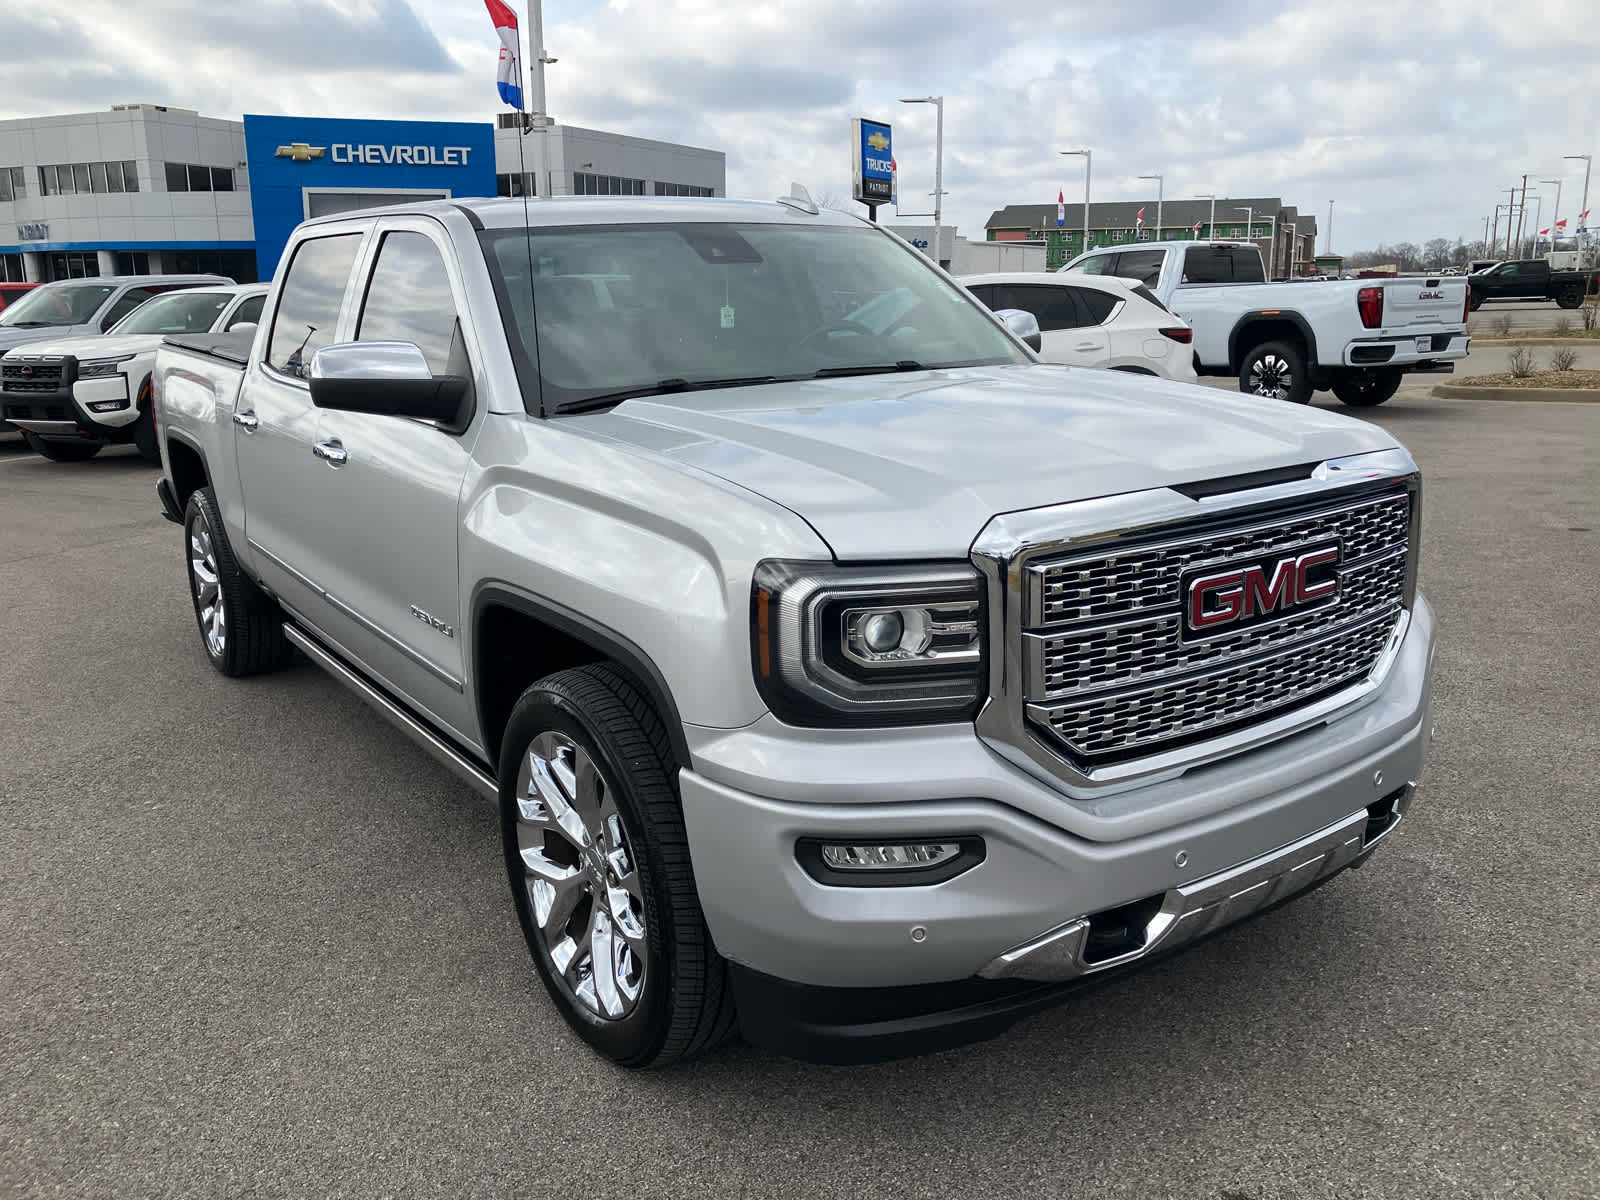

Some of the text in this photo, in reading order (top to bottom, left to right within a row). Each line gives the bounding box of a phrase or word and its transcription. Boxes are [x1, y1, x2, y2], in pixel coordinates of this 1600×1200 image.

[331, 143, 472, 166] CHEVROLET
[866, 157, 892, 173] TRUCKS
[1189, 547, 1340, 631] GMC
[410, 604, 454, 638] DENALI
